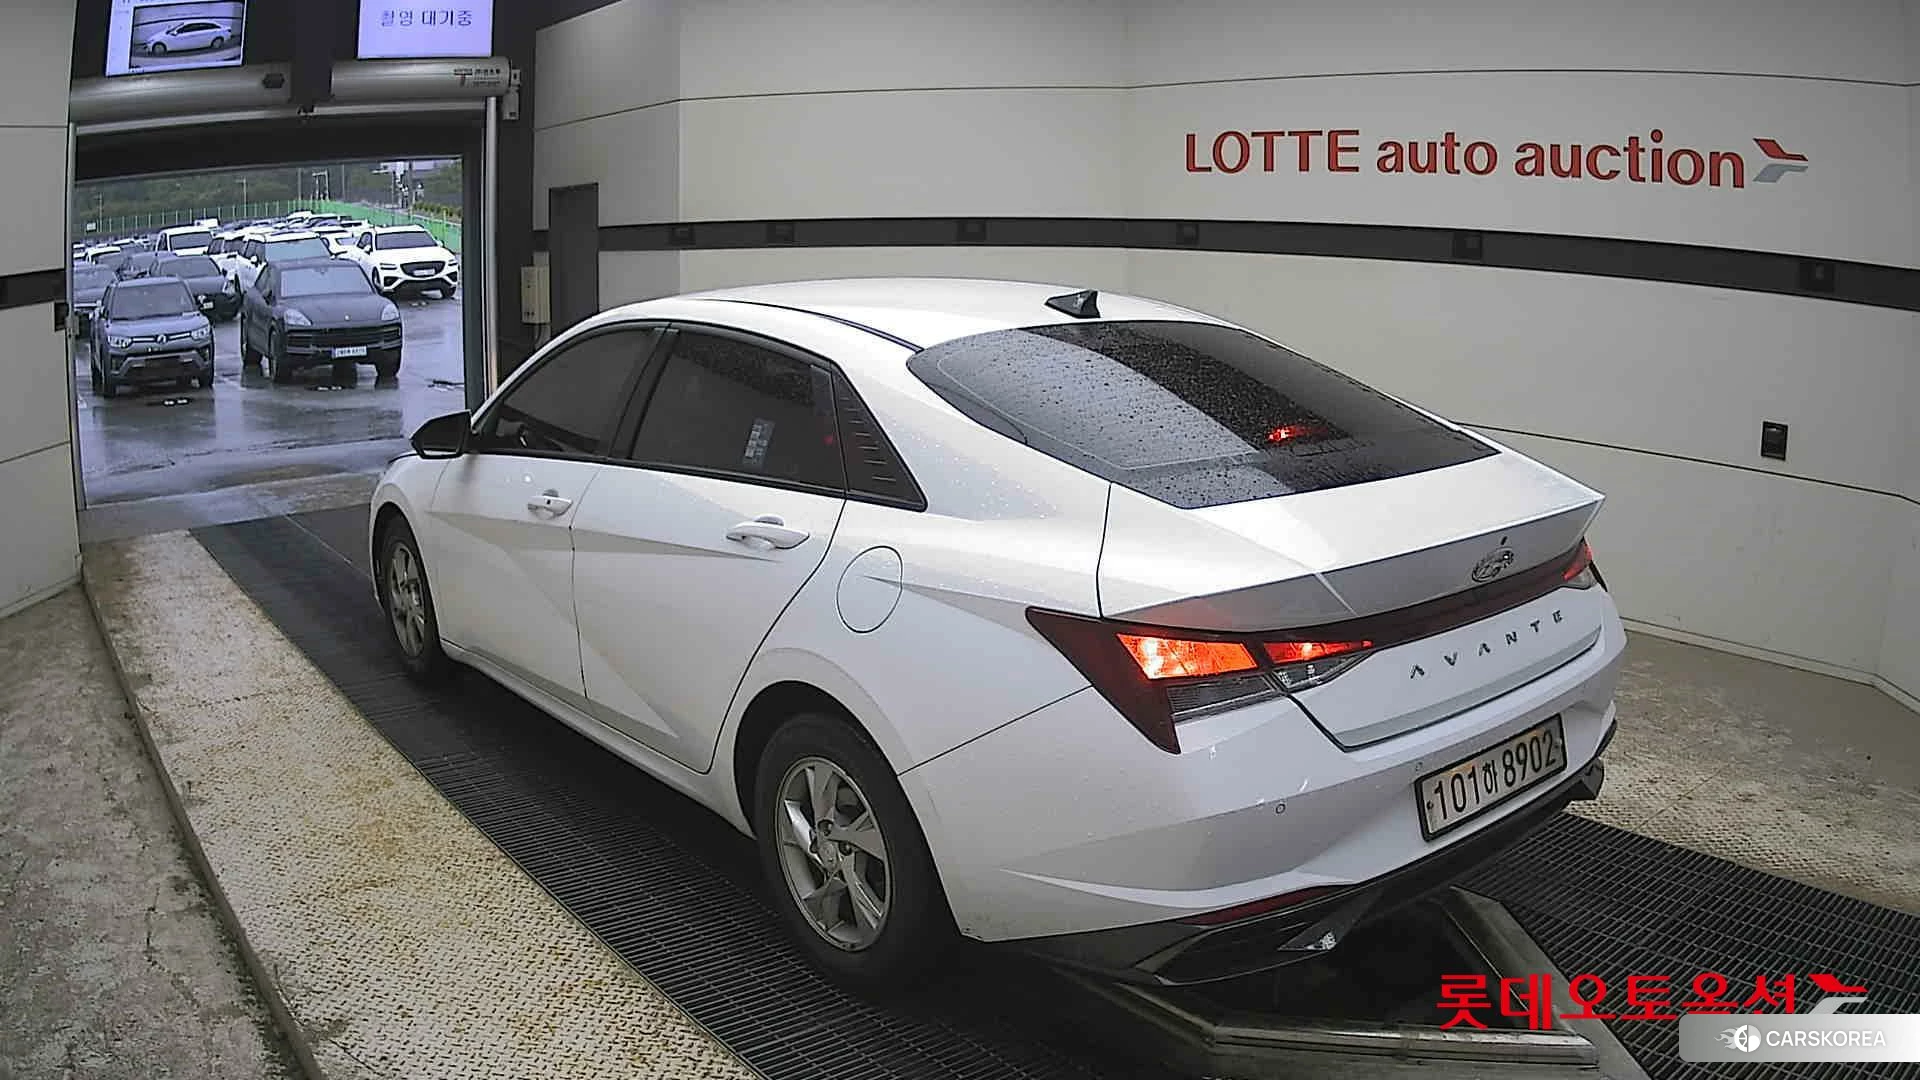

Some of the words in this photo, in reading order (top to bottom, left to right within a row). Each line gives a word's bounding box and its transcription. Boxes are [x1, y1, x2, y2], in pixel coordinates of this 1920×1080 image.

[422, 10, 472, 26] 대기중
[1185, 129, 1360, 174] LOTTE
[1376, 131, 1498, 175] auto
[1514, 128, 1745, 189] auction
[1410, 610, 1563, 679] AVANTE
